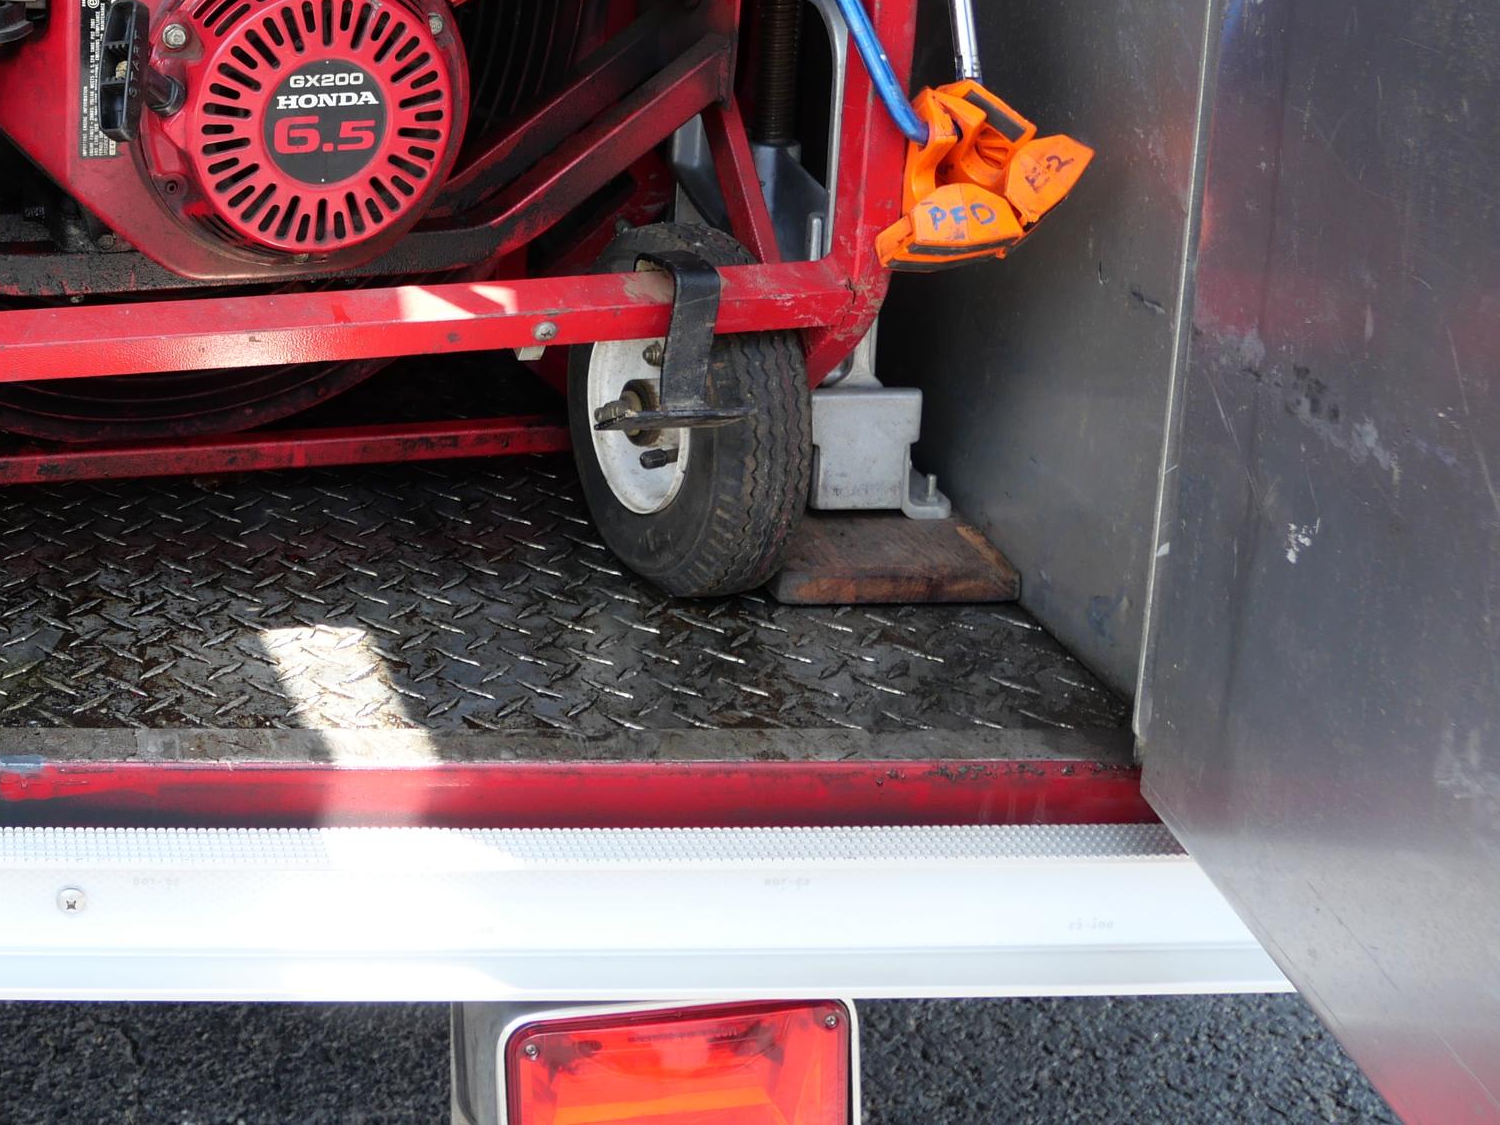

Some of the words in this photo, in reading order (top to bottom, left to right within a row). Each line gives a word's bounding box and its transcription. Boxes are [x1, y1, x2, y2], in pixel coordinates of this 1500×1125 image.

[288, 72, 364, 88] GX200
[276, 91, 379, 110] HONDA
[273, 115, 376, 155] 6.5
